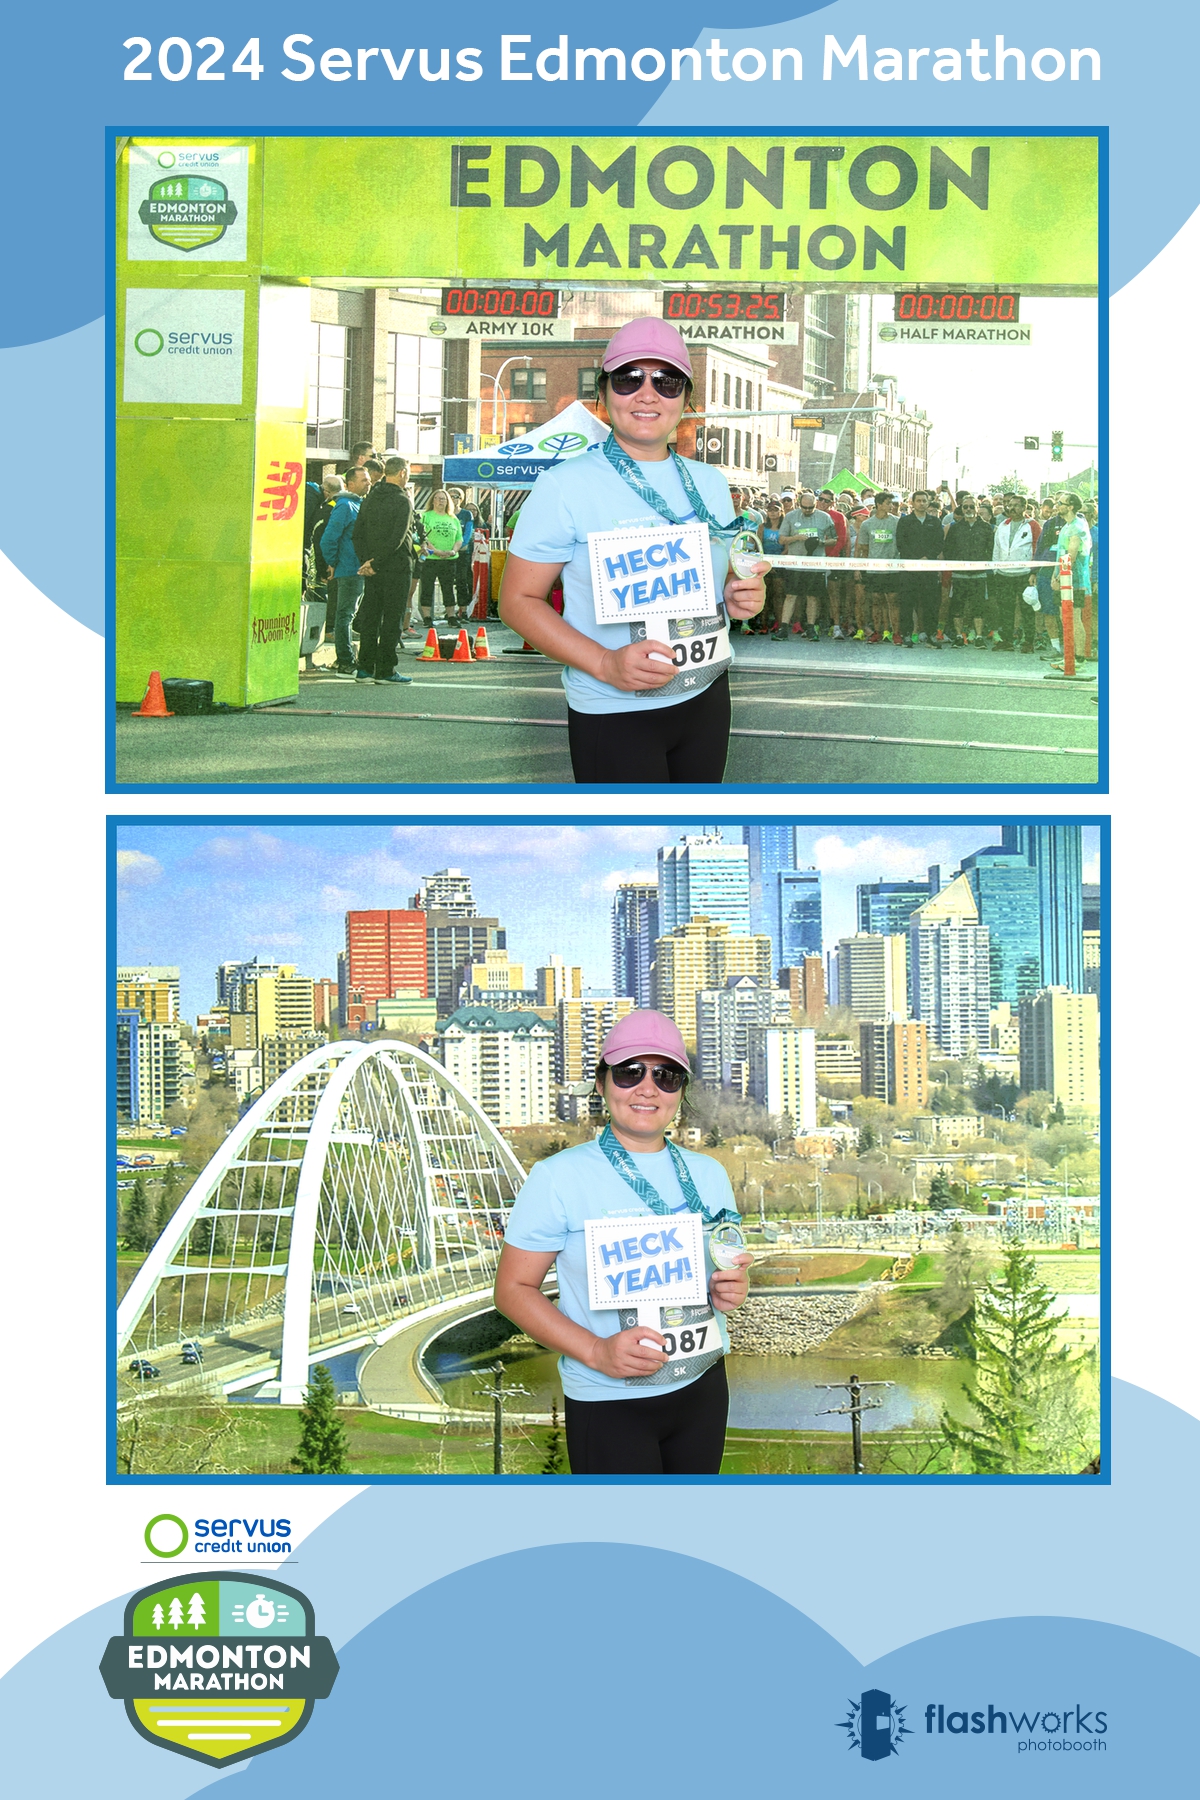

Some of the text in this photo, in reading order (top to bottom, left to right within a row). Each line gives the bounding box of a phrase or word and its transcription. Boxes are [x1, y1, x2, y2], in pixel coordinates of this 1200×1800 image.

[178, 152, 220, 161] servus
[450, 145, 990, 211] EDMONTON
[149, 203, 227, 214] EDMONTON
[160, 214, 215, 222] MARATHON
[522, 222, 907, 272] MARATHON
[465, 321, 554, 336] ARMY 10K
[679, 325, 785, 340] MARATHON
[900, 327, 1031, 341] HALF MARATHON
[168, 332, 233, 345] servus
[167, 345, 233, 355] credit union
[496, 465, 545, 475] servus
[602, 537, 691, 582] HECK
[609, 567, 702, 612] YEAH!
[257, 613, 291, 637] Running
[683, 676, 697, 687] 5K
[598, 1226, 684, 1269] HECK
[603, 1256, 693, 1299] YEAH!
[673, 1366, 687, 1377] 5K
